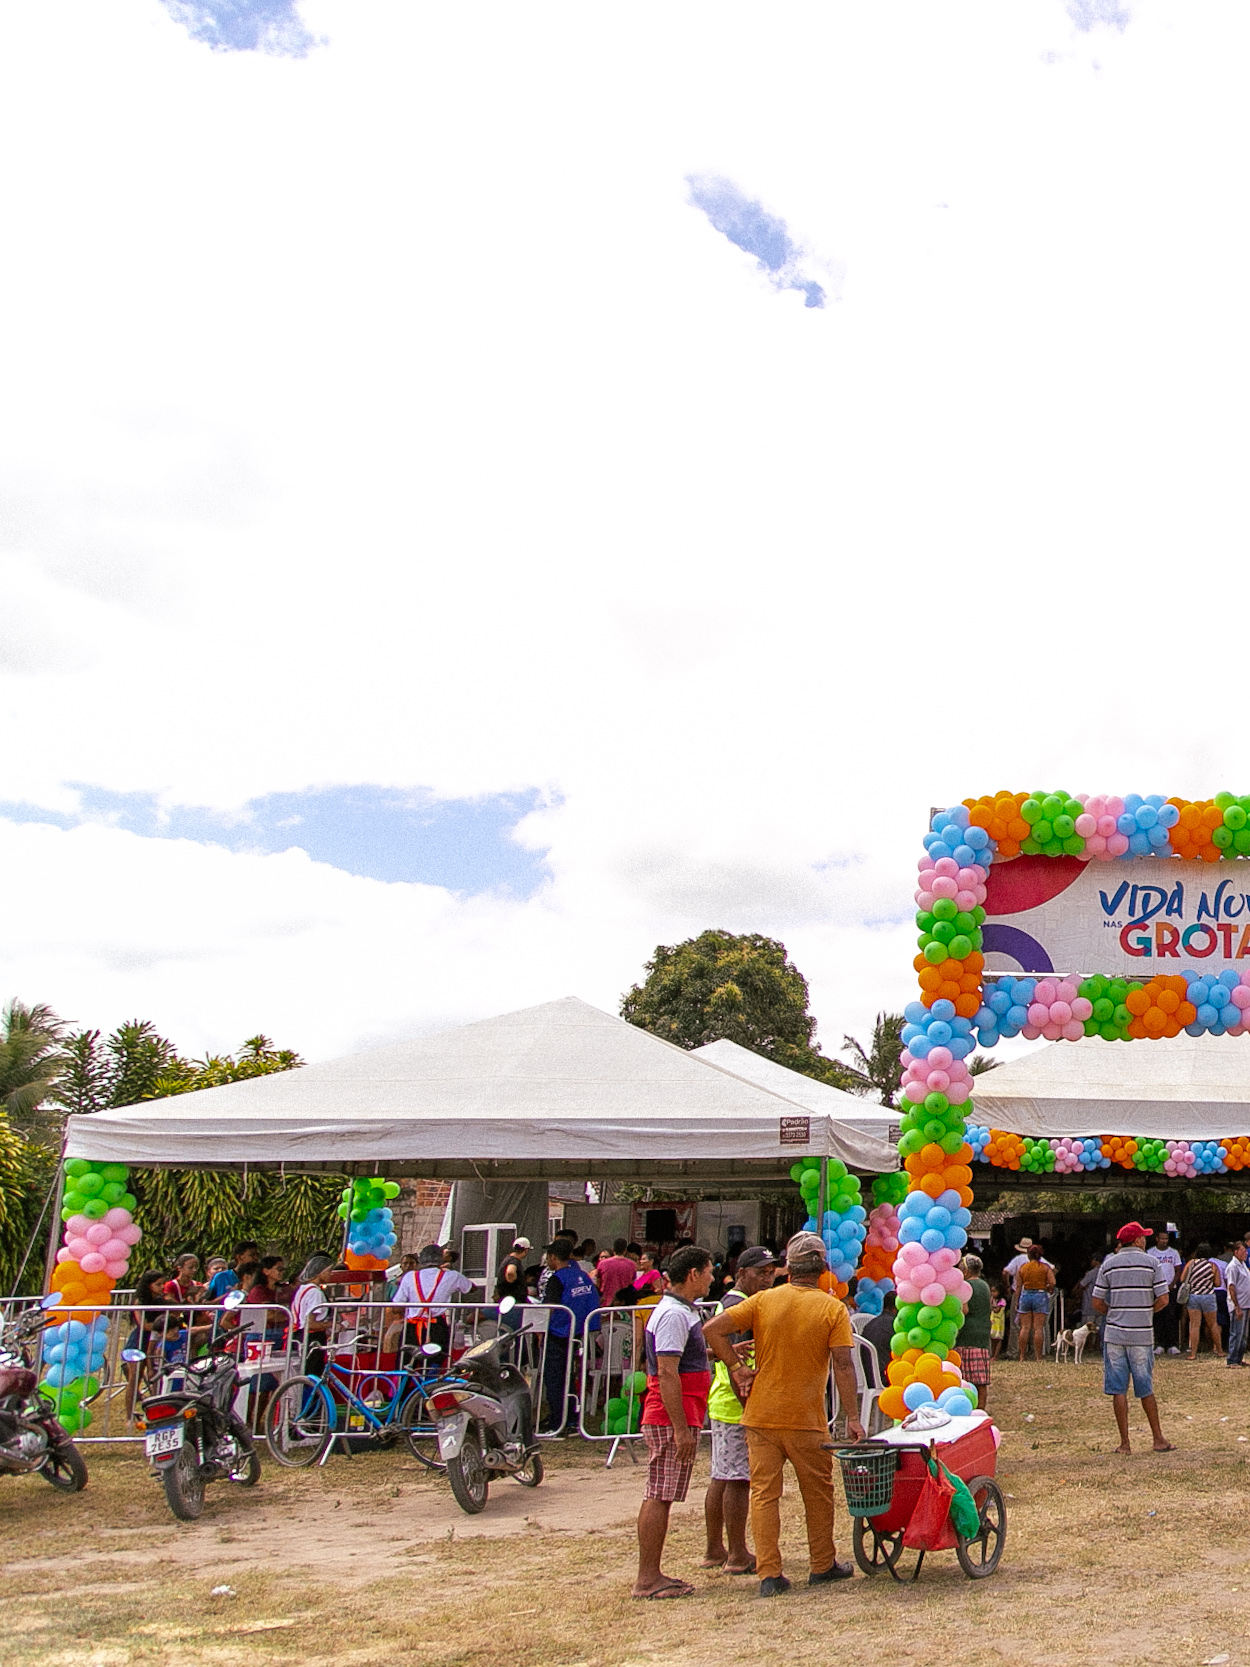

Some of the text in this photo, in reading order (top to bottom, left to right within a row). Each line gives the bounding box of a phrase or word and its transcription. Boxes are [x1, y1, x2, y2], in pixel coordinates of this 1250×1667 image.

[1099, 880, 1184, 926] VIDA
[1103, 920, 1123, 929] NAS
[155, 1431, 176, 1442] RGP
[151, 1438, 179, 1453] 2E35
